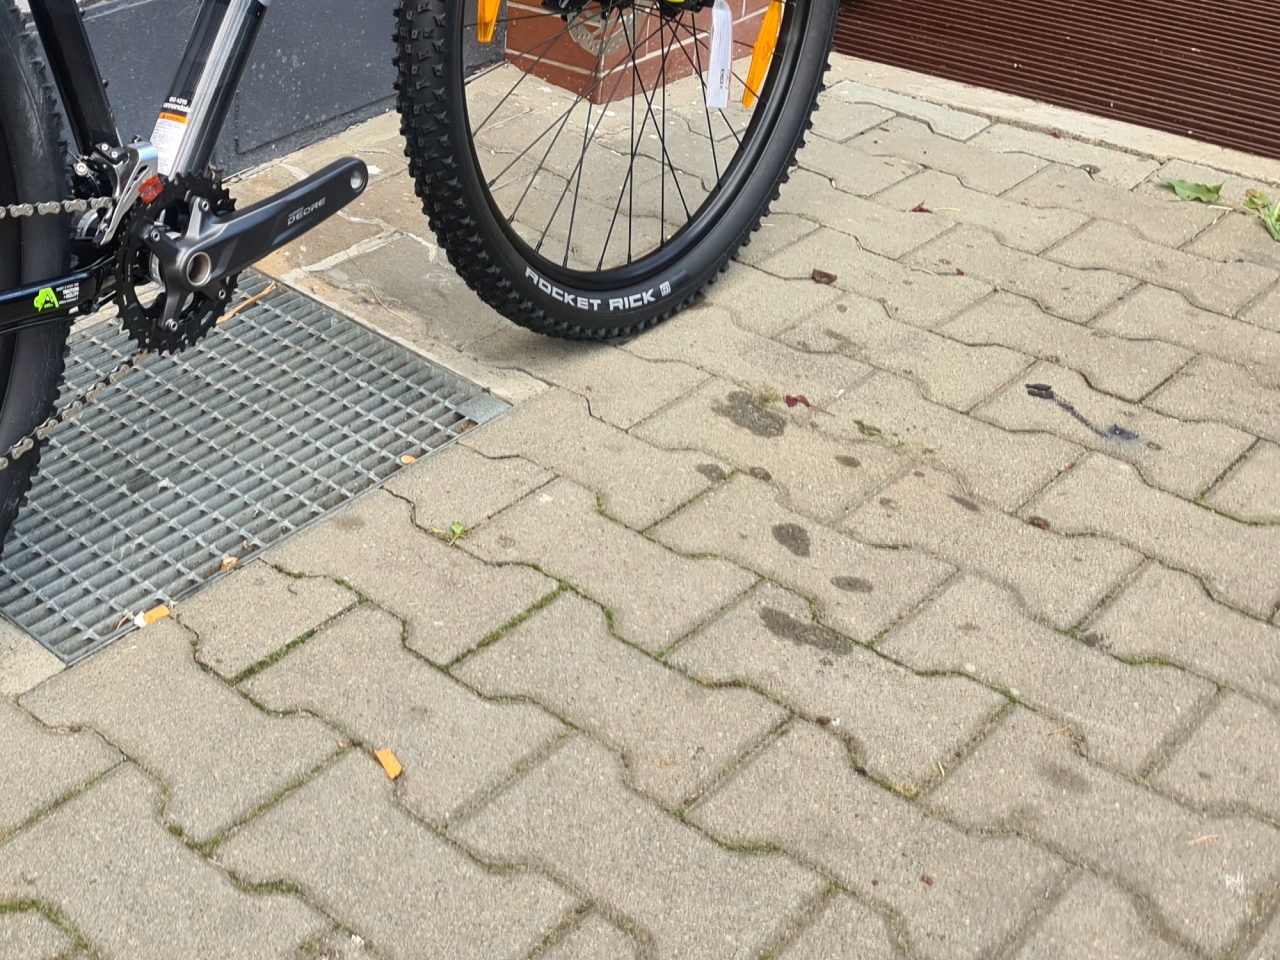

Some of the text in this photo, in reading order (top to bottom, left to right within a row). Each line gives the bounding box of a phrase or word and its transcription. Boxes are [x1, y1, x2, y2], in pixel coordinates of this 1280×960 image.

[287, 197, 326, 226] DEORE
[524, 266, 657, 312] ROCKET RICK
